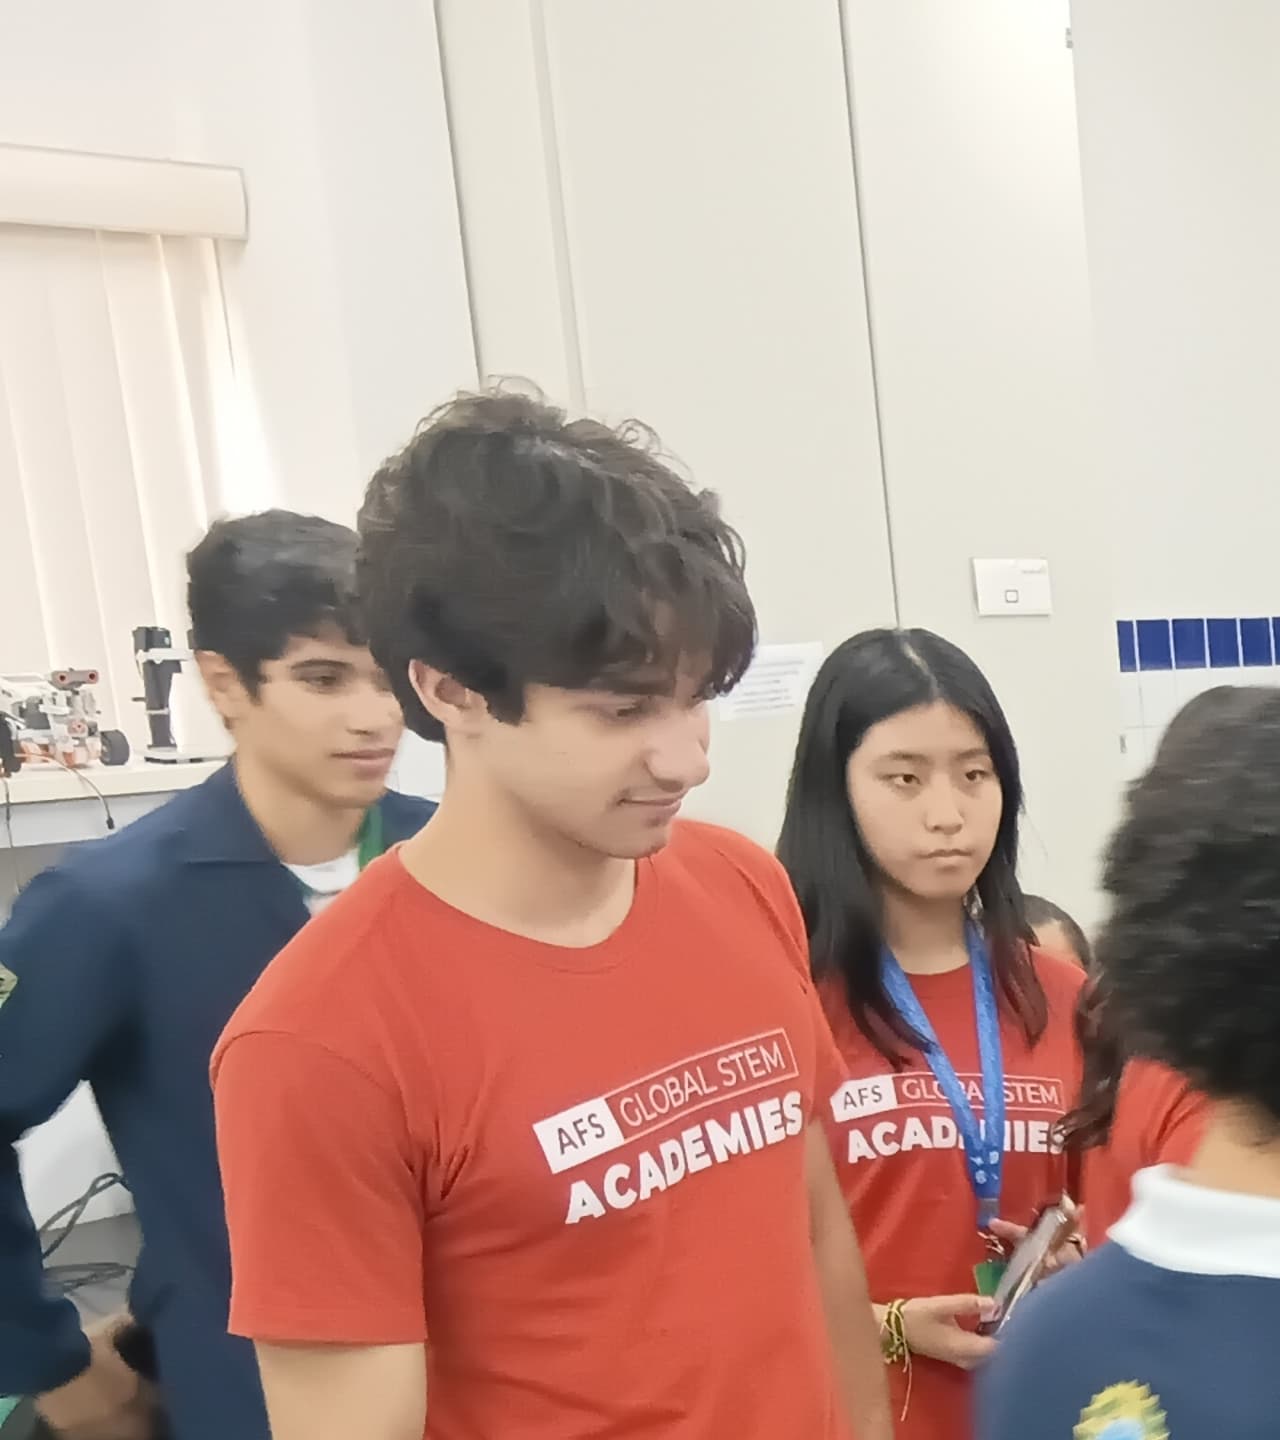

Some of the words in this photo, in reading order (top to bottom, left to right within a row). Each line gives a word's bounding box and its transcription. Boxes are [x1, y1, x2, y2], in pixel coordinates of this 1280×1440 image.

[556, 1112, 606, 1156] AFS
[619, 1065, 718, 1128] GLOBAL
[716, 1040, 786, 1087] STEM
[842, 1083, 884, 1111] AFS
[1003, 1082, 1060, 1105] STEM
[564, 1090, 803, 1225] ACADEMIES
